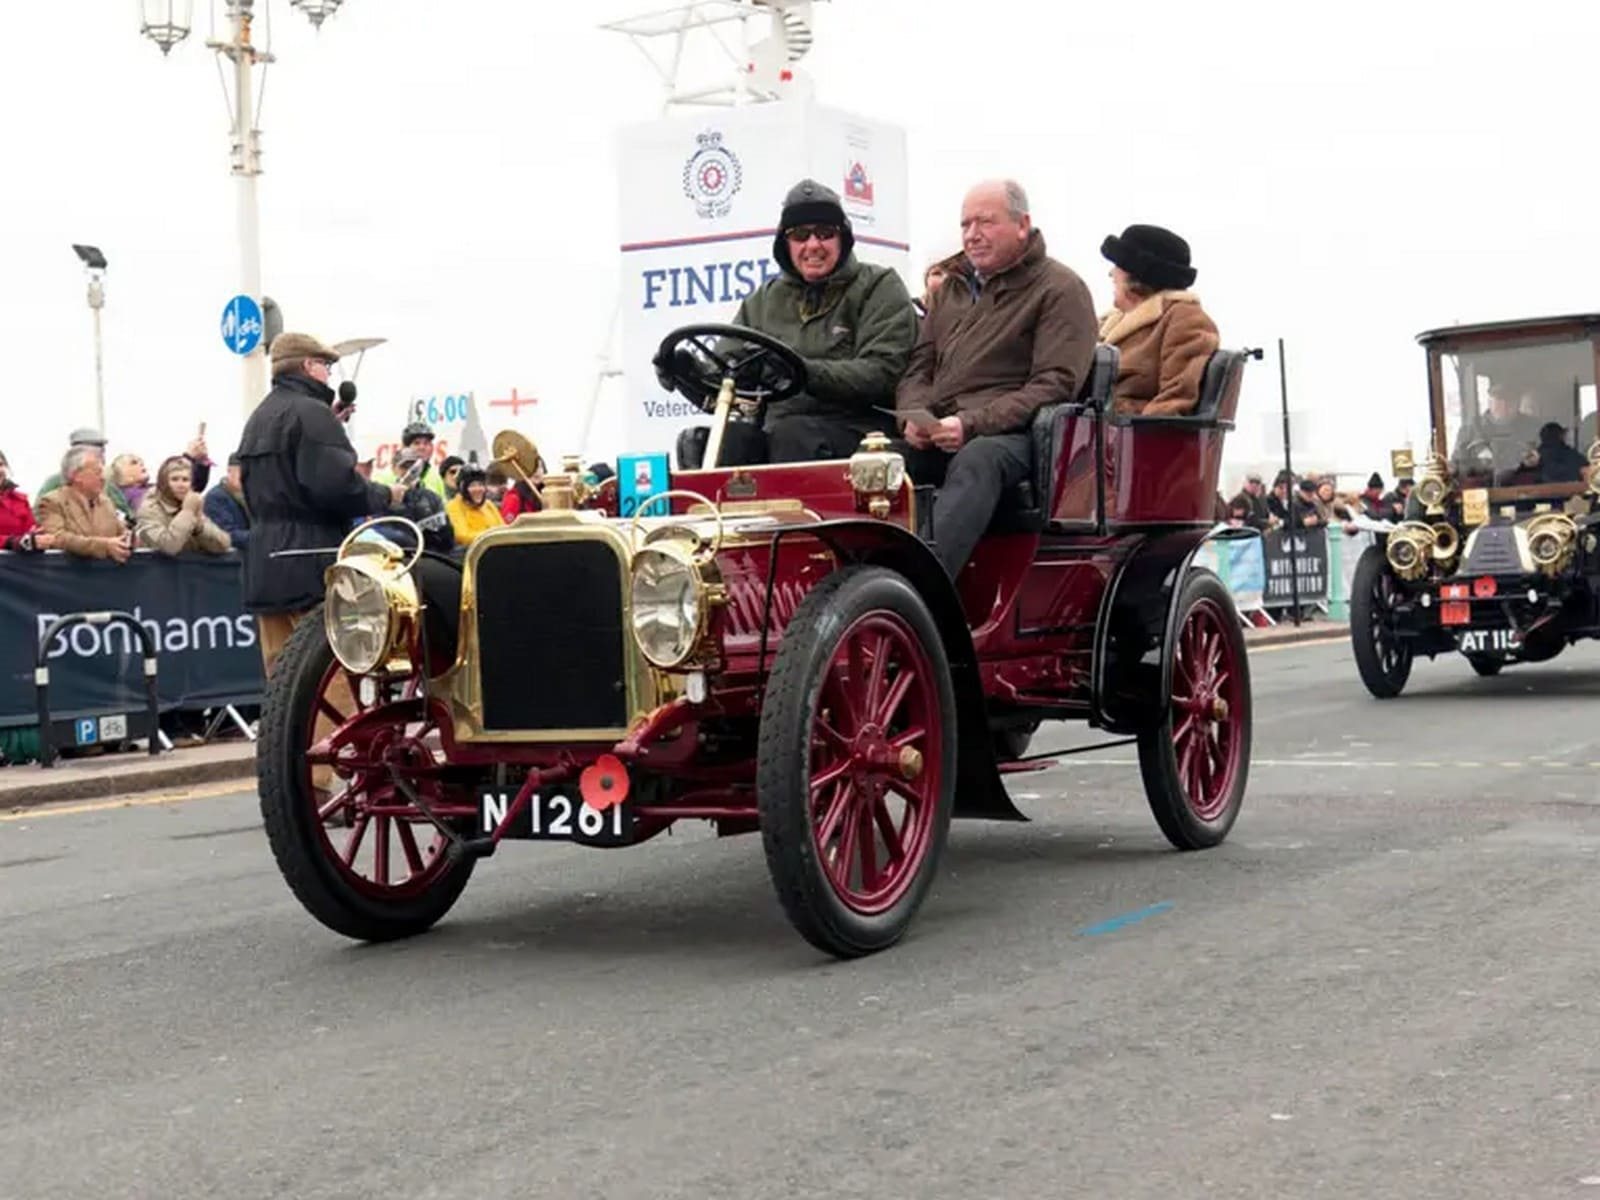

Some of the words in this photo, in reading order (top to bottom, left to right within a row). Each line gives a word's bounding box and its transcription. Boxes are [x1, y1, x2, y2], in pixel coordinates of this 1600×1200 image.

[37, 606, 256, 660] Bonhams
[1461, 630, 1488, 651] AT
[80, 720, 93, 745] P
[483, 793, 507, 832] N
[531, 794, 622, 836] 1261
